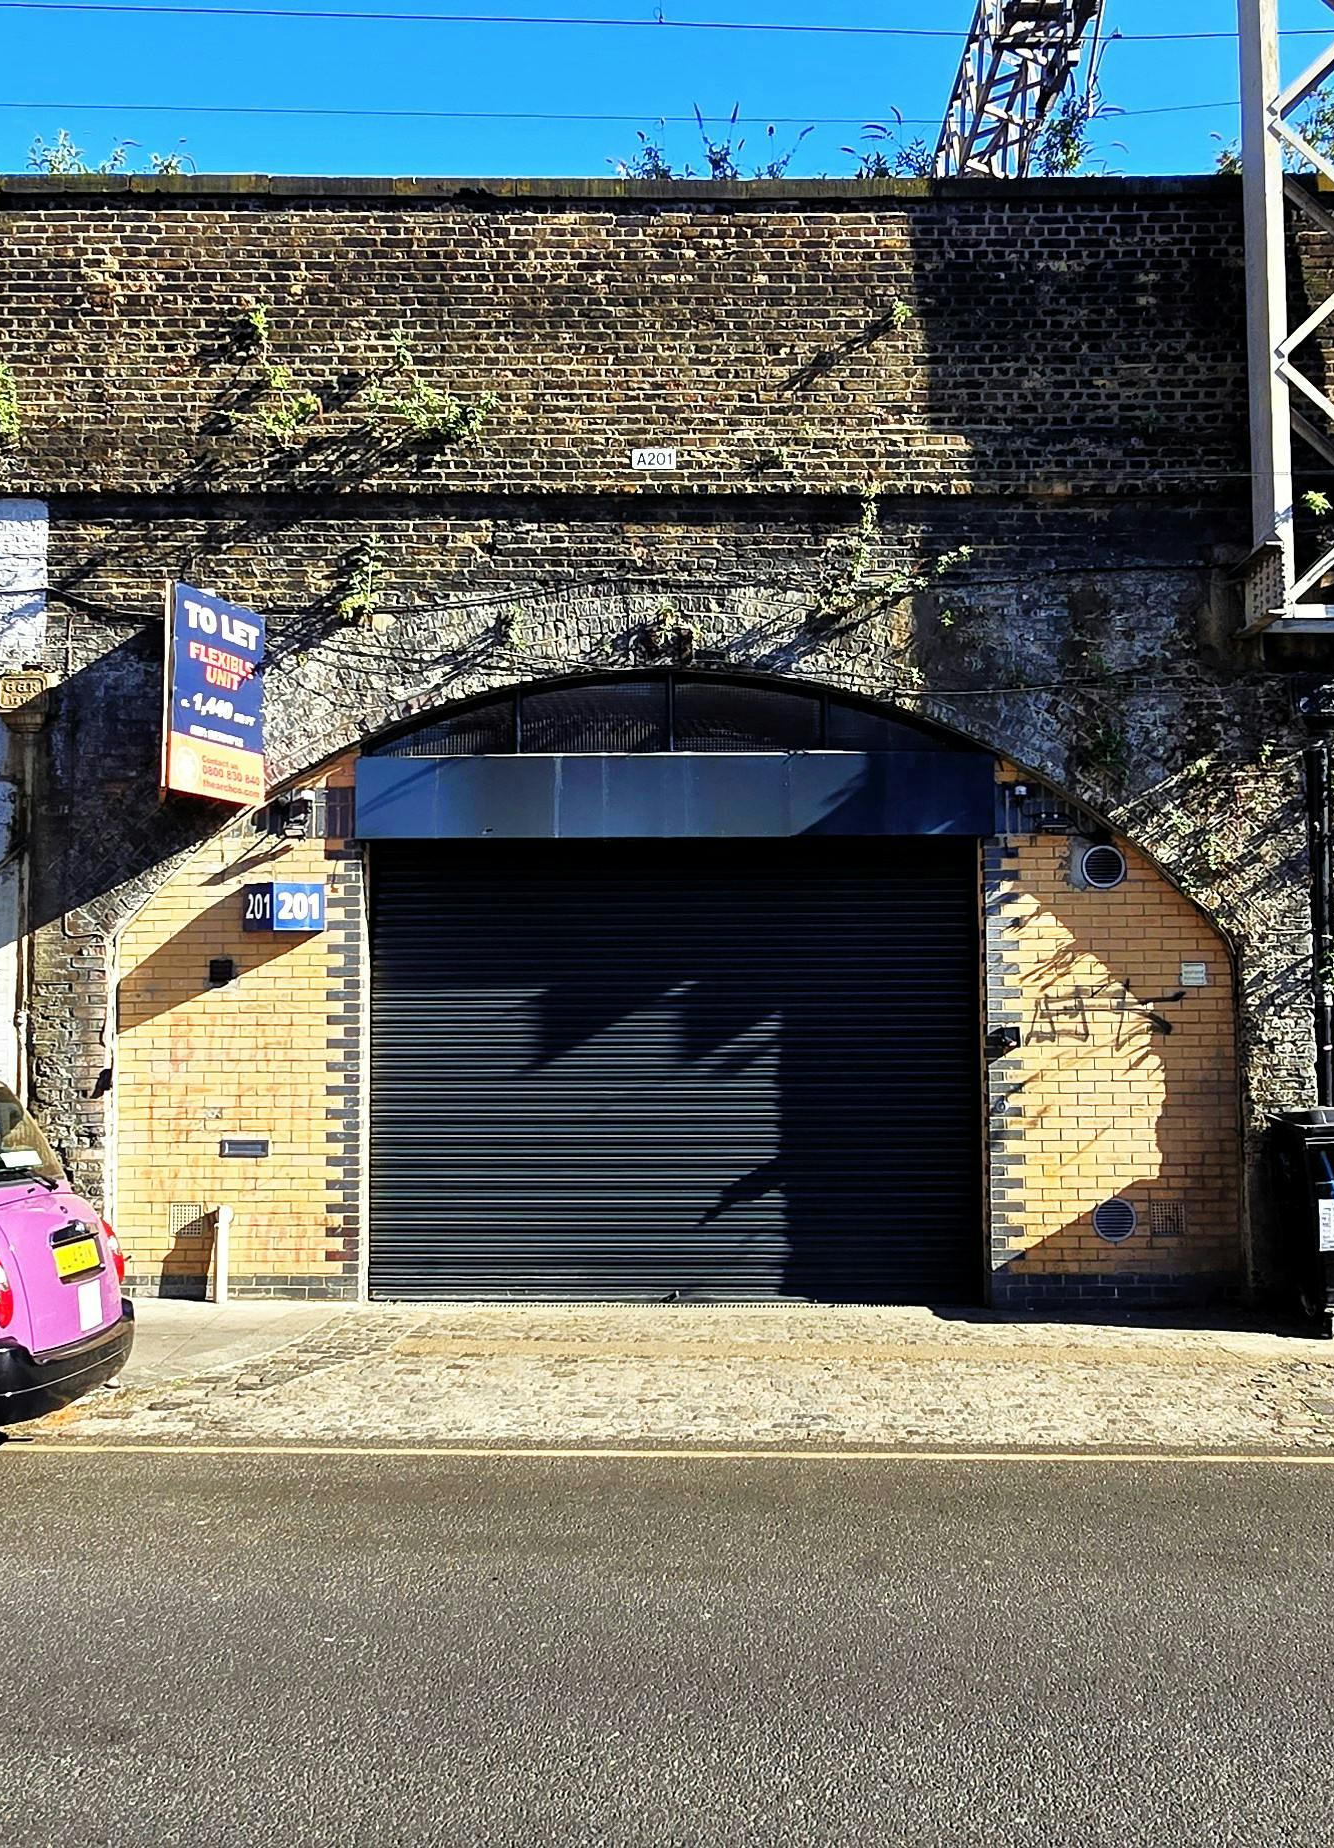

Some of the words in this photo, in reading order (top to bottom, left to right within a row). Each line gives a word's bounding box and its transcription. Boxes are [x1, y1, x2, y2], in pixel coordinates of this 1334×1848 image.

[636, 452, 672, 466] A201
[184, 600, 217, 634] TO
[221, 614, 260, 650] LET
[190, 641, 254, 680] FLEXIBLE
[206, 665, 241, 690] UNIT
[202, 755, 229, 768] Contact
[203, 765, 224, 777] 0800
[227, 770, 243, 782] 830
[245, 893, 270, 919] 201
[278, 891, 320, 919] 201
